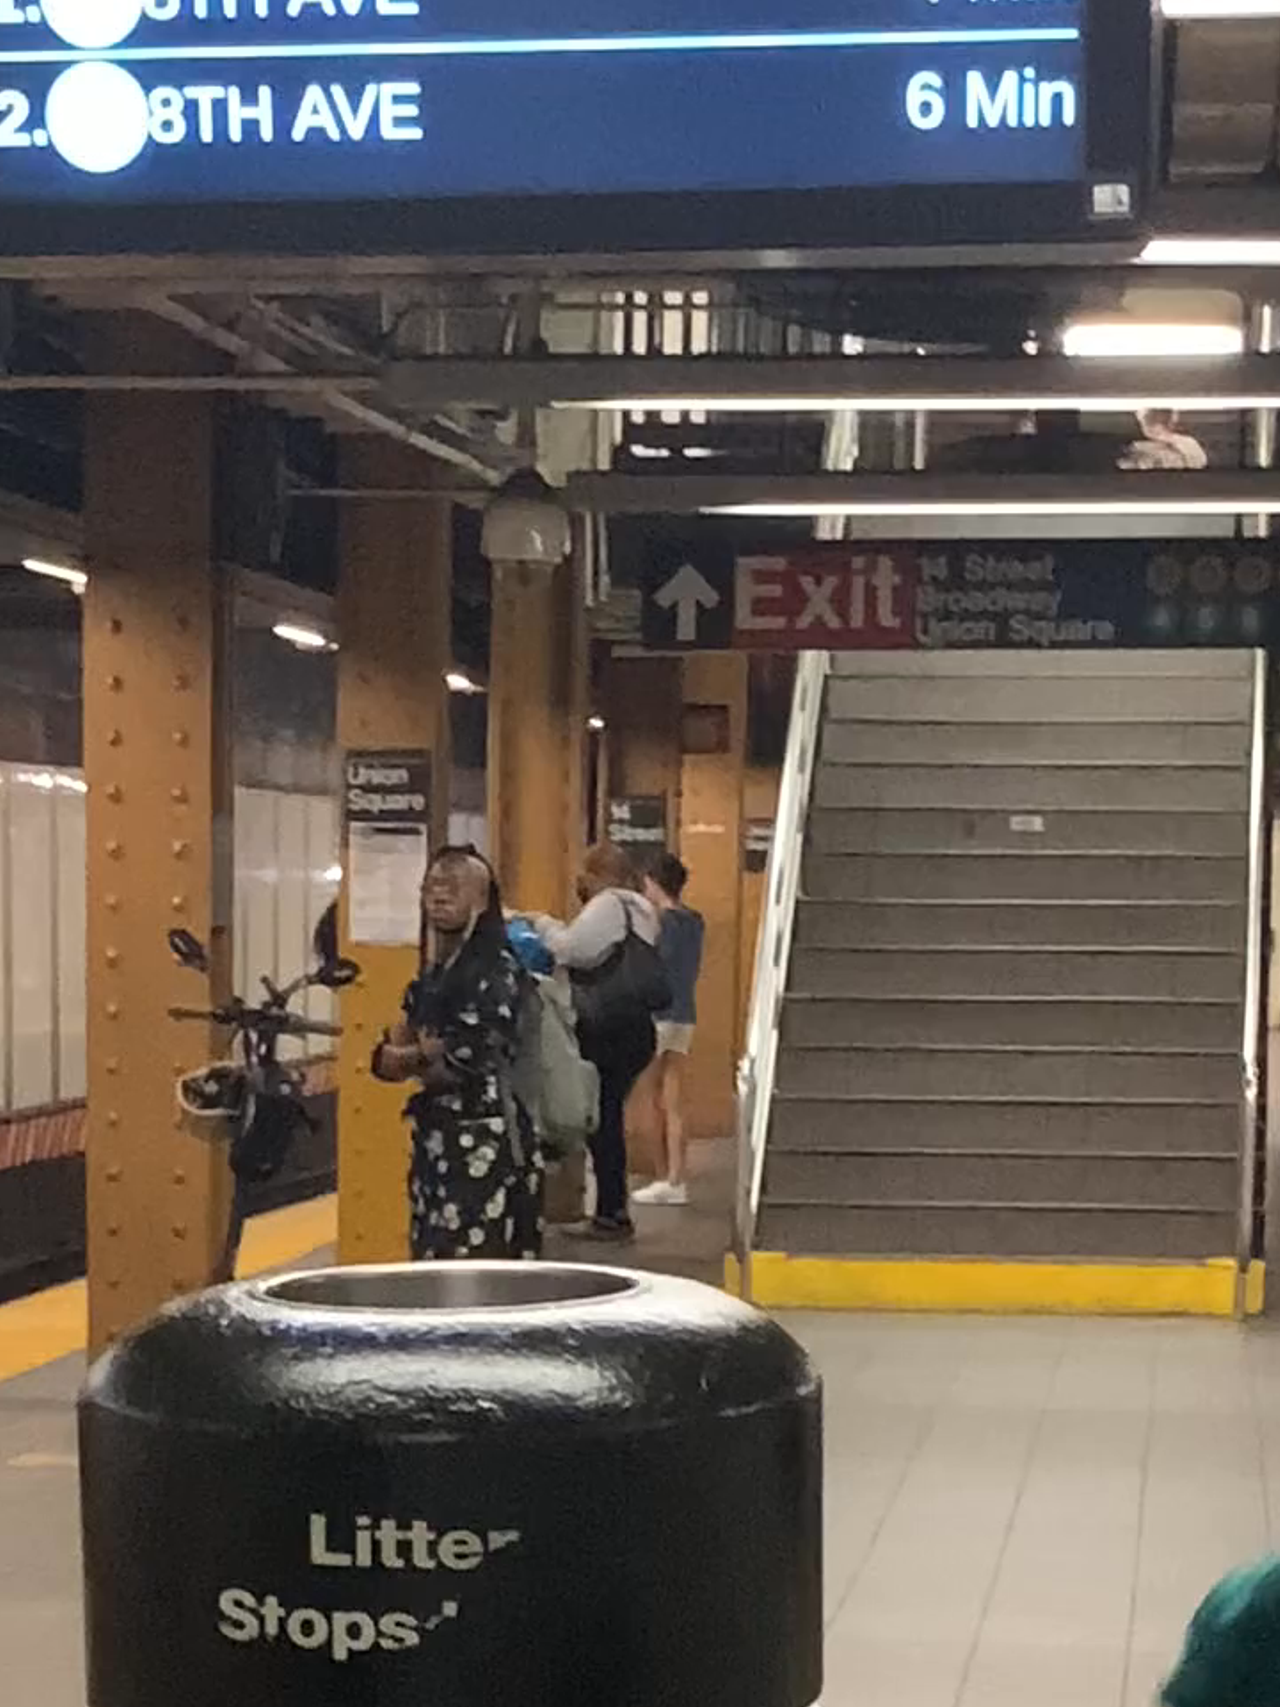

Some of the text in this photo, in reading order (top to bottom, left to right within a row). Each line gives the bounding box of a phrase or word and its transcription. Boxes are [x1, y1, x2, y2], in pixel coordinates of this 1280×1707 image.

[148, 85, 274, 144] 8TH
[291, 82, 424, 142] AVE
[905, 70, 946, 130] 6
[966, 66, 1075, 127] Min
[963, 553, 1054, 582] Street
[734, 554, 902, 631] Exit
[917, 586, 1062, 616] Broadway
[916, 614, 996, 647] Union
[1008, 615, 1115, 647] Square
[347, 765, 409, 787] Union
[347, 788, 425, 814] Square
[218, 1588, 421, 1662] Stops
